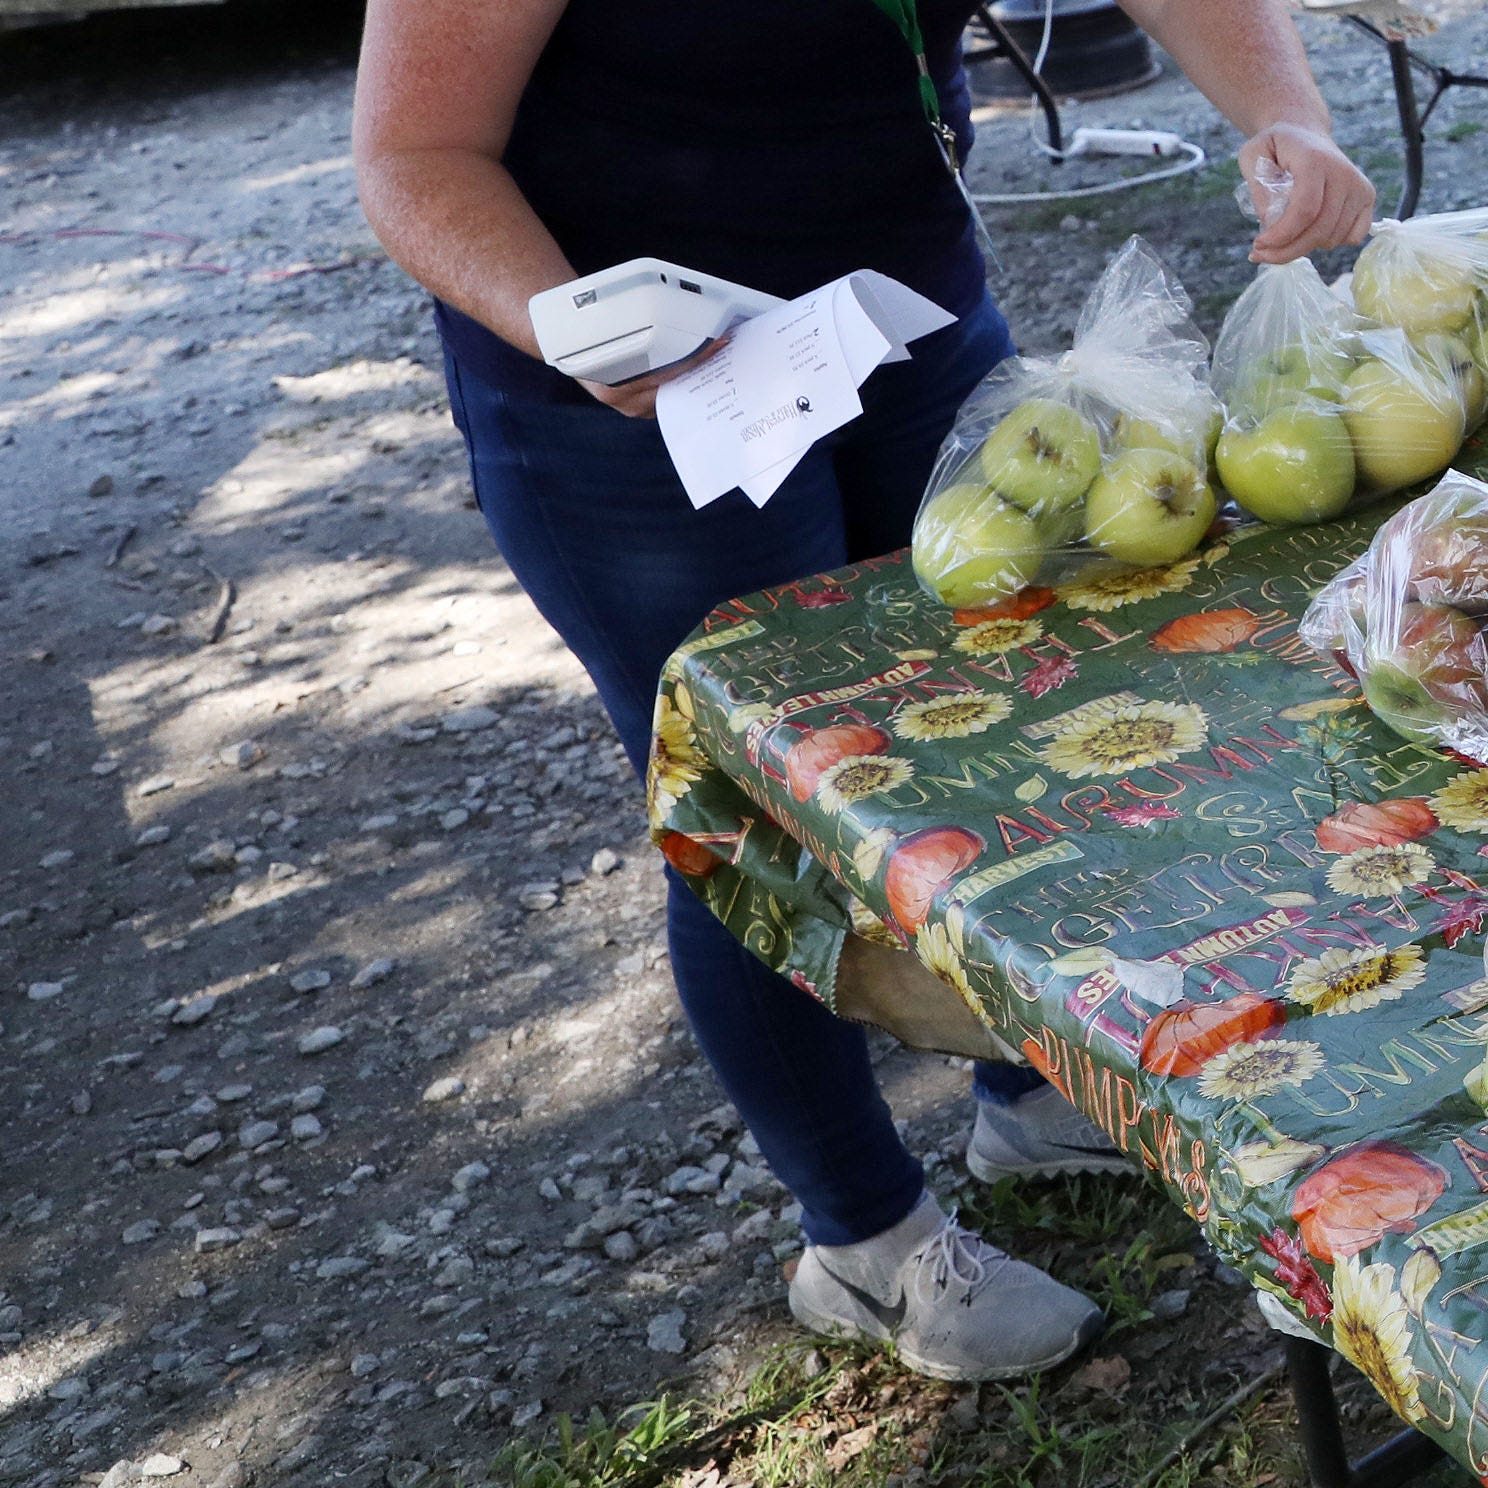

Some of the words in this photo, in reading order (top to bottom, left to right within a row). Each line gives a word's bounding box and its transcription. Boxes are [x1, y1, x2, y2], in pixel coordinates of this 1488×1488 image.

[816, 661, 915, 704] AUTUMN
[954, 844, 1069, 901] HARVEST
[1184, 909, 1293, 966] AUTUMN
